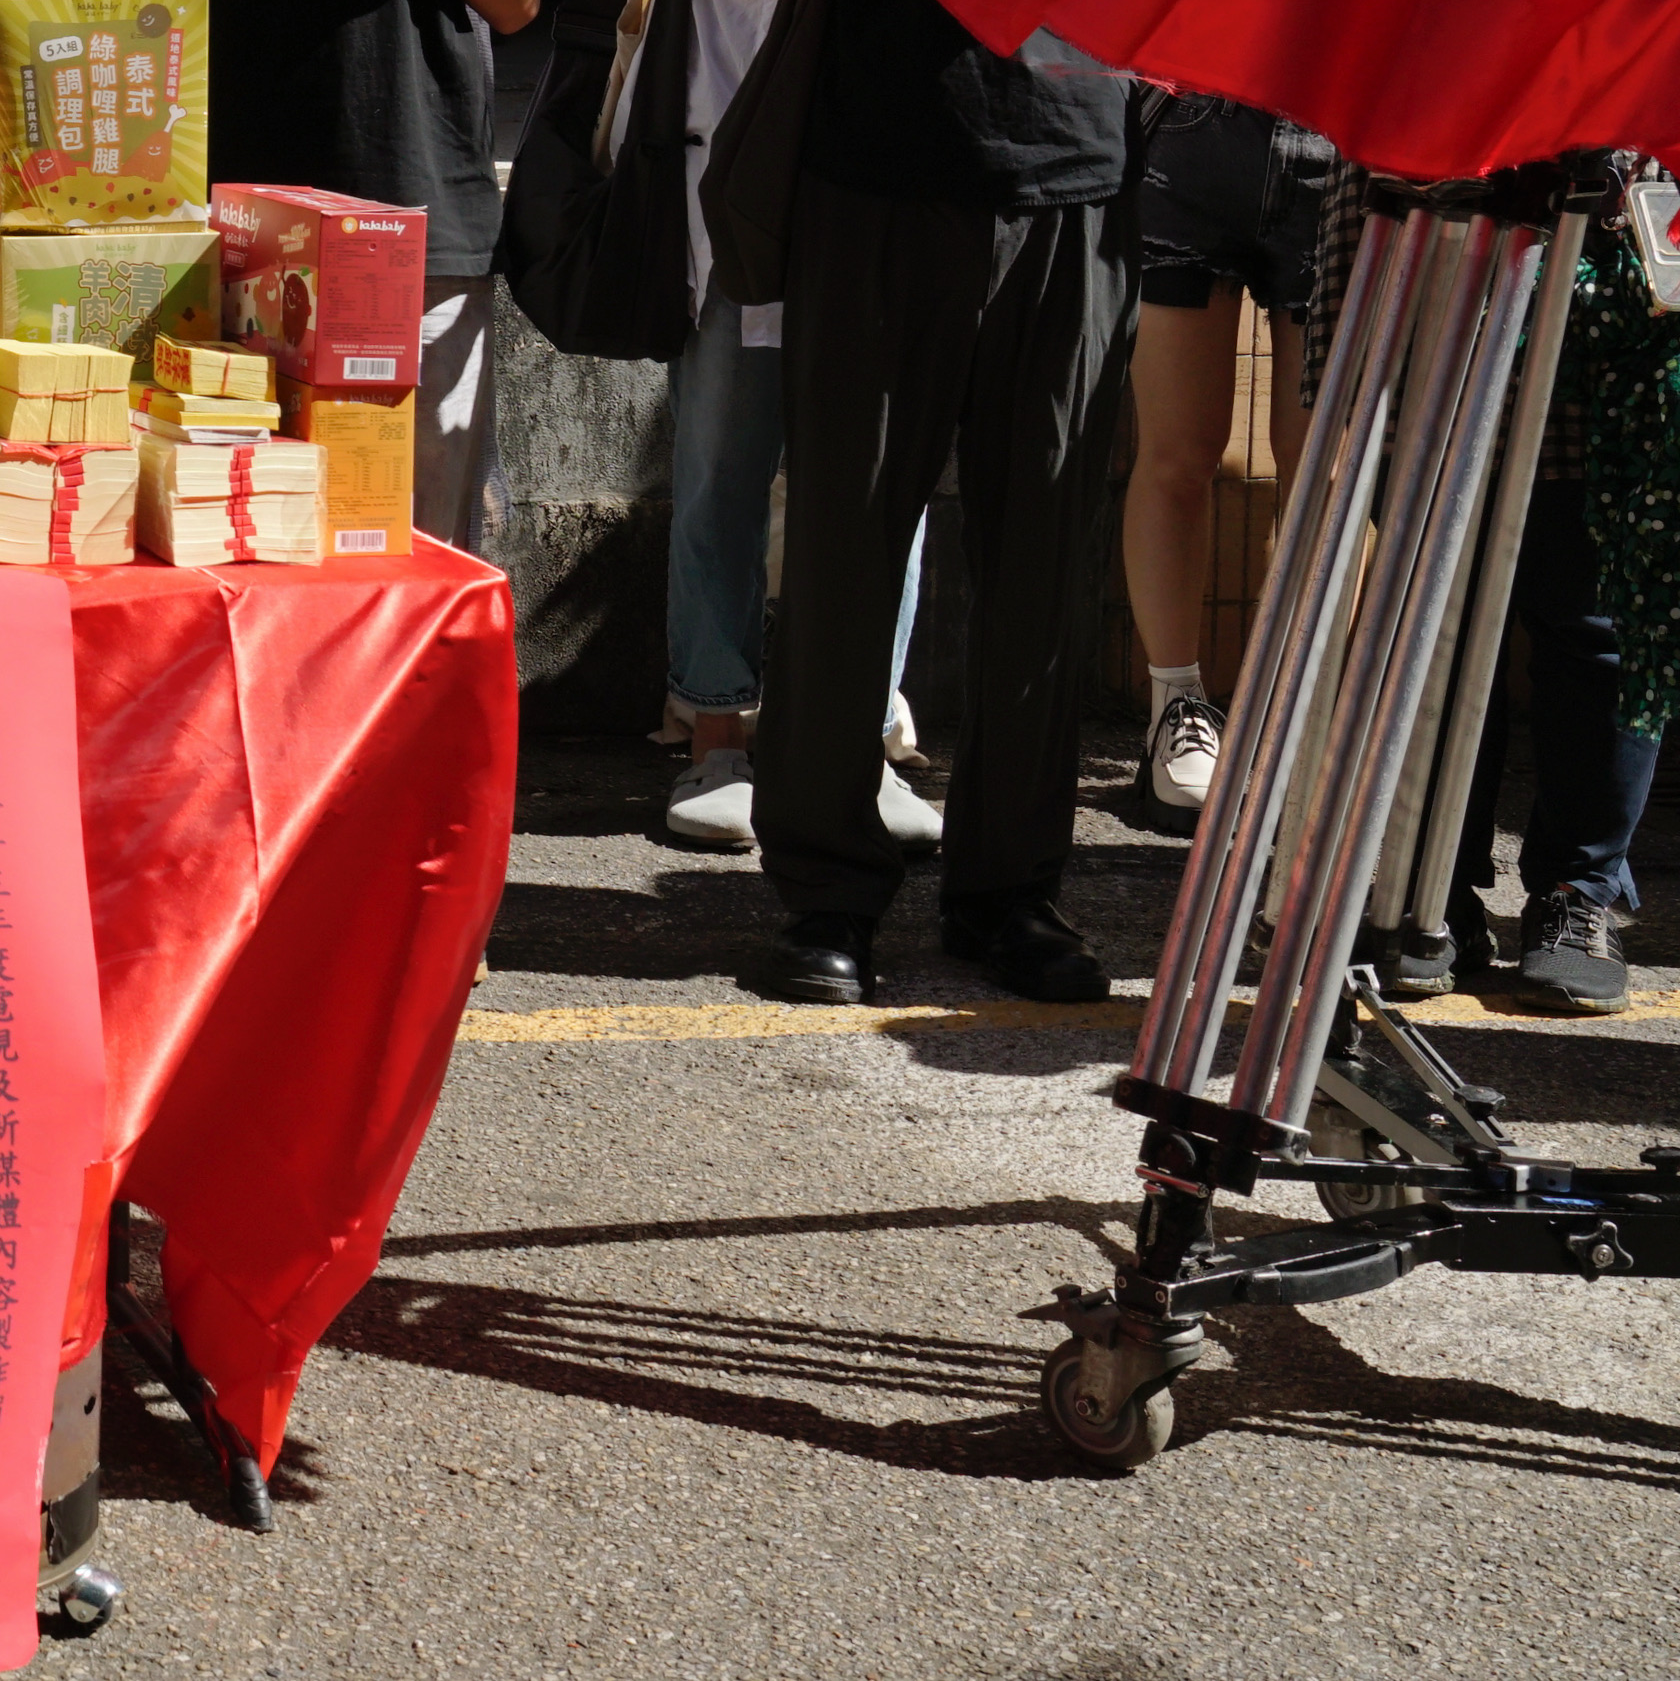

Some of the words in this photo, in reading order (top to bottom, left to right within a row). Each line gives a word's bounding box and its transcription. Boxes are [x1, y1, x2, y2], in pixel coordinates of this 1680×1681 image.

[46, 40, 79, 57] 5入組
[54, 69, 84, 151] 調理包
[90, 34, 120, 175] 綠咖哩雞腿
[125, 55, 155, 116] 泰式
